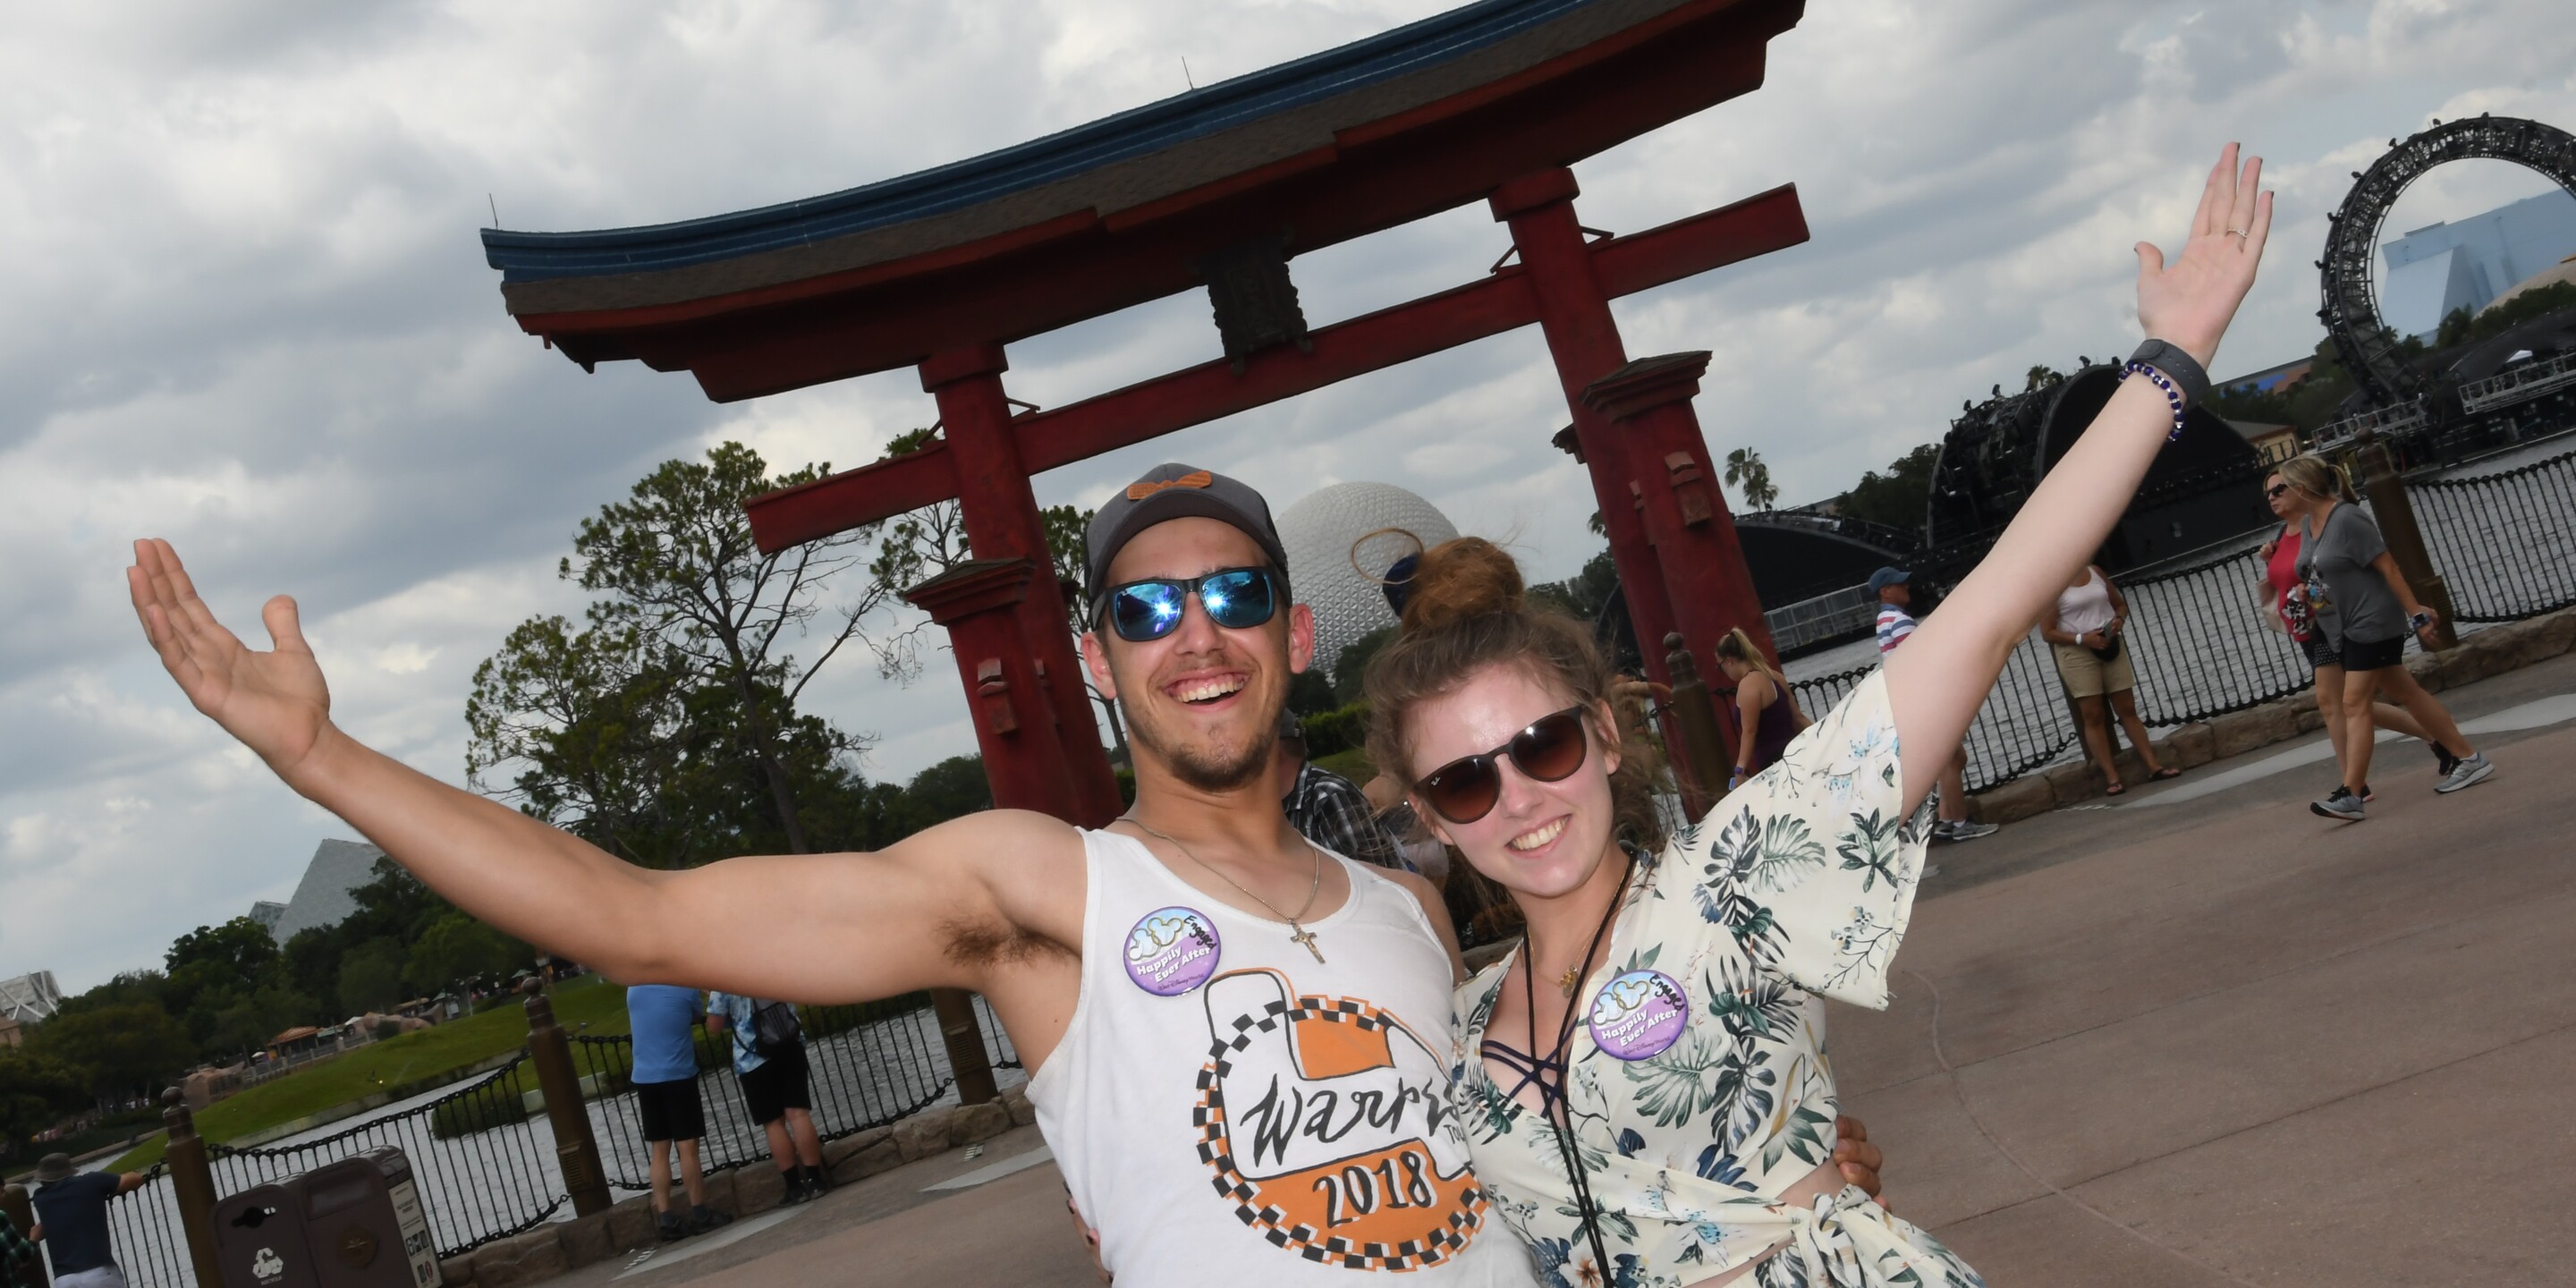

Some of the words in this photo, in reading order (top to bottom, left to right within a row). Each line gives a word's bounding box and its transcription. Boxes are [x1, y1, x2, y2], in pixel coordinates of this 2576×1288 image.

[1137, 946, 1182, 976] Happily
[1155, 962, 1180, 983] Ever
[1182, 947, 1211, 966] After
[1601, 1010, 1648, 1039] Happily
[1620, 1026, 1646, 1046] Ever
[1647, 1010, 1678, 1030] After
[1313, 1150, 1435, 1229] 2018
